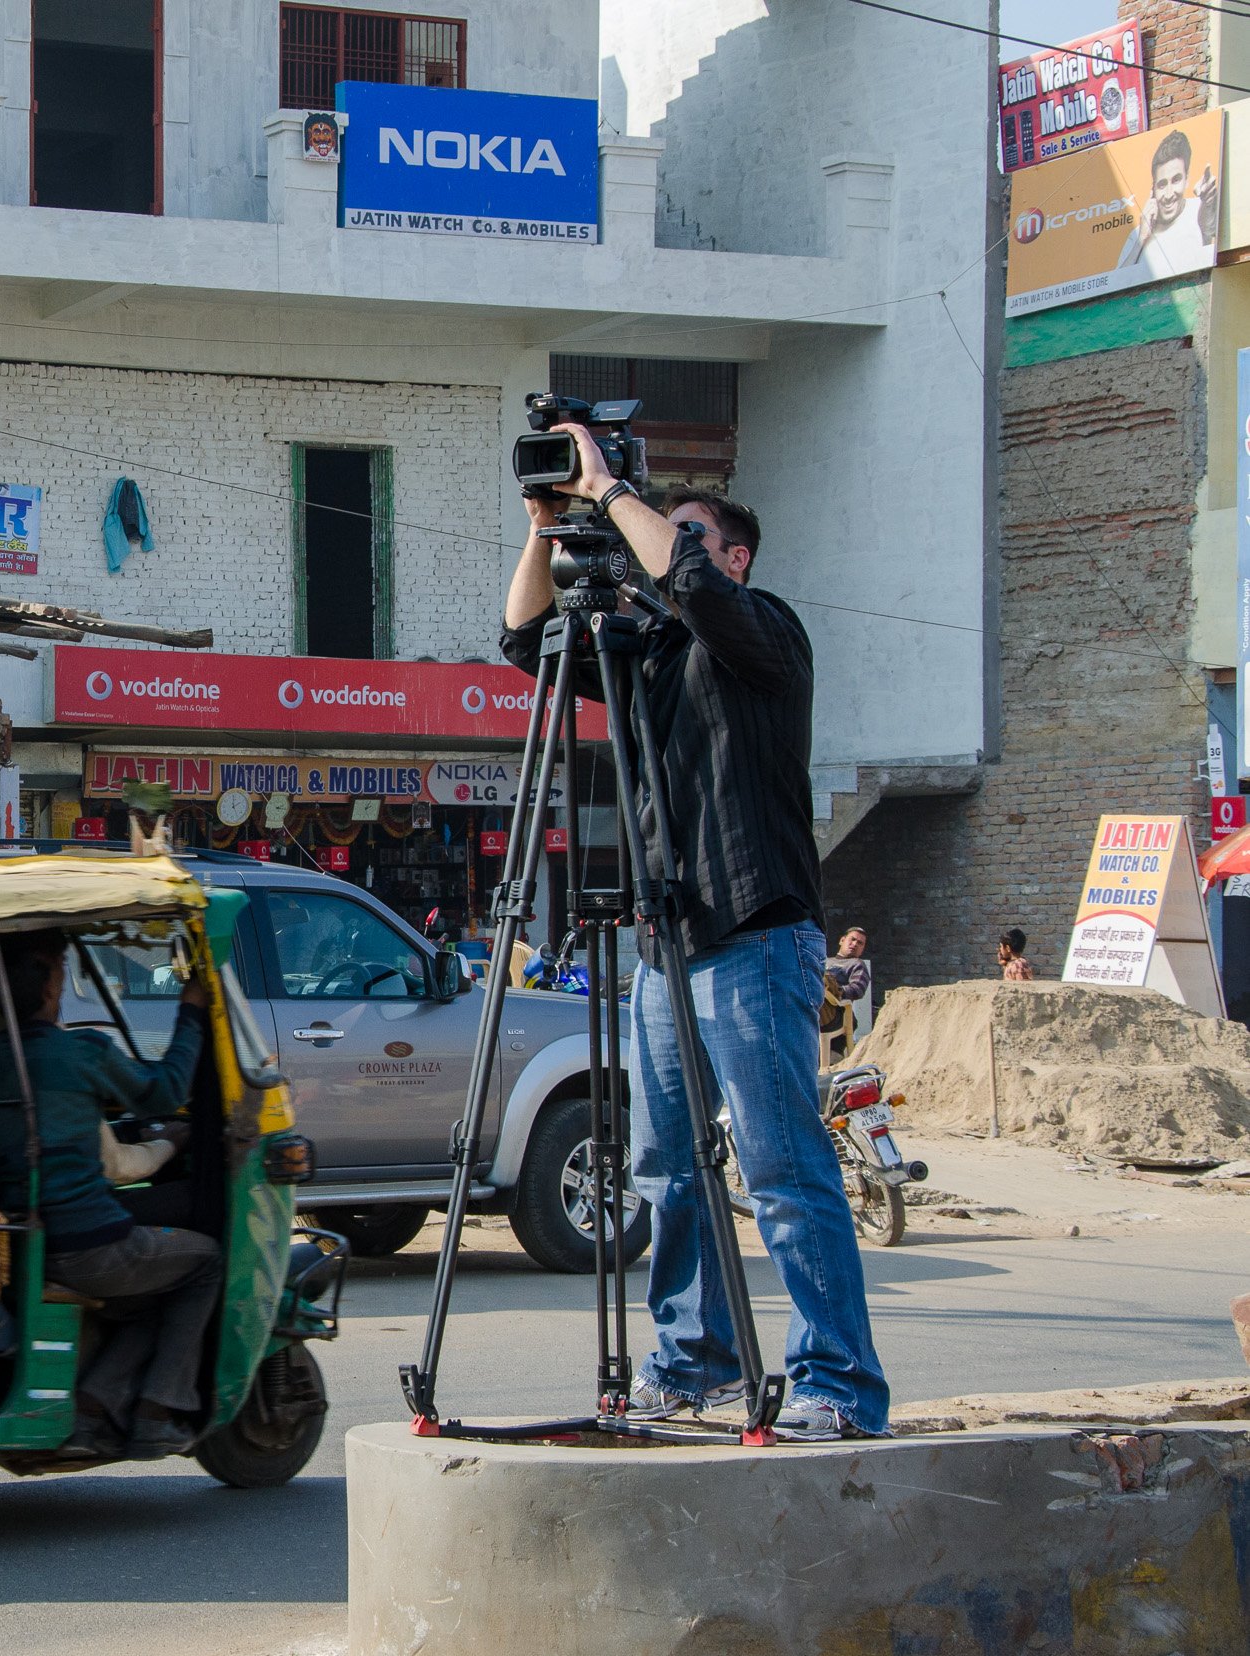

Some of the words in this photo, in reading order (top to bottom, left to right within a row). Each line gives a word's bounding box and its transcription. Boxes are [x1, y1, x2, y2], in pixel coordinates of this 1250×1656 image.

[1002, 66, 1037, 108] Jatin
[1039, 47, 1088, 95] Watch
[1091, 39, 1119, 79] Co.
[1122, 29, 1136, 67] &
[1039, 89, 1098, 137] Mobile
[379, 127, 567, 176] NOKIA
[1040, 143, 1059, 157] Sale
[1061, 138, 1068, 150] &
[1070, 131, 1100, 147] Service
[351, 211, 402, 227] JATIN
[407, 215, 464, 231] WATCH
[500, 221, 512, 235] &
[516, 222, 589, 239] MOBILES
[1092, 214, 1134, 233] mobile
[1010, 296, 1029, 309] JATIN
[1030, 291, 1054, 303] WATCH
[1055, 288, 1061, 298] &
[1061, 281, 1086, 296] MOBILE
[1087, 276, 1109, 290] STORE
[119, 677, 220, 700] vodafone
[310, 685, 406, 707] vodafone
[155, 703, 170, 711] Jatin
[170, 704, 189, 712] Watch
[195, 705, 220, 713] Opticals
[1210, 747, 1221, 757] 3G
[91, 755, 212, 794] JATIN
[220, 764, 272, 793] WATCH
[277, 764, 302, 795] CO.
[308, 769, 325, 795] &
[328, 766, 422, 796] MOBILES
[437, 764, 508, 781] NOKIA
[1099, 821, 1175, 852] JATIN
[1098, 854, 1140, 873] WATCH
[1141, 854, 1160, 873] CO.
[1121, 875, 1130, 885] &
[1086, 888, 1158, 906] MOBILES
[358, 1062, 405, 1073] CROWNE
[409, 1062, 442, 1073] PLAZA
